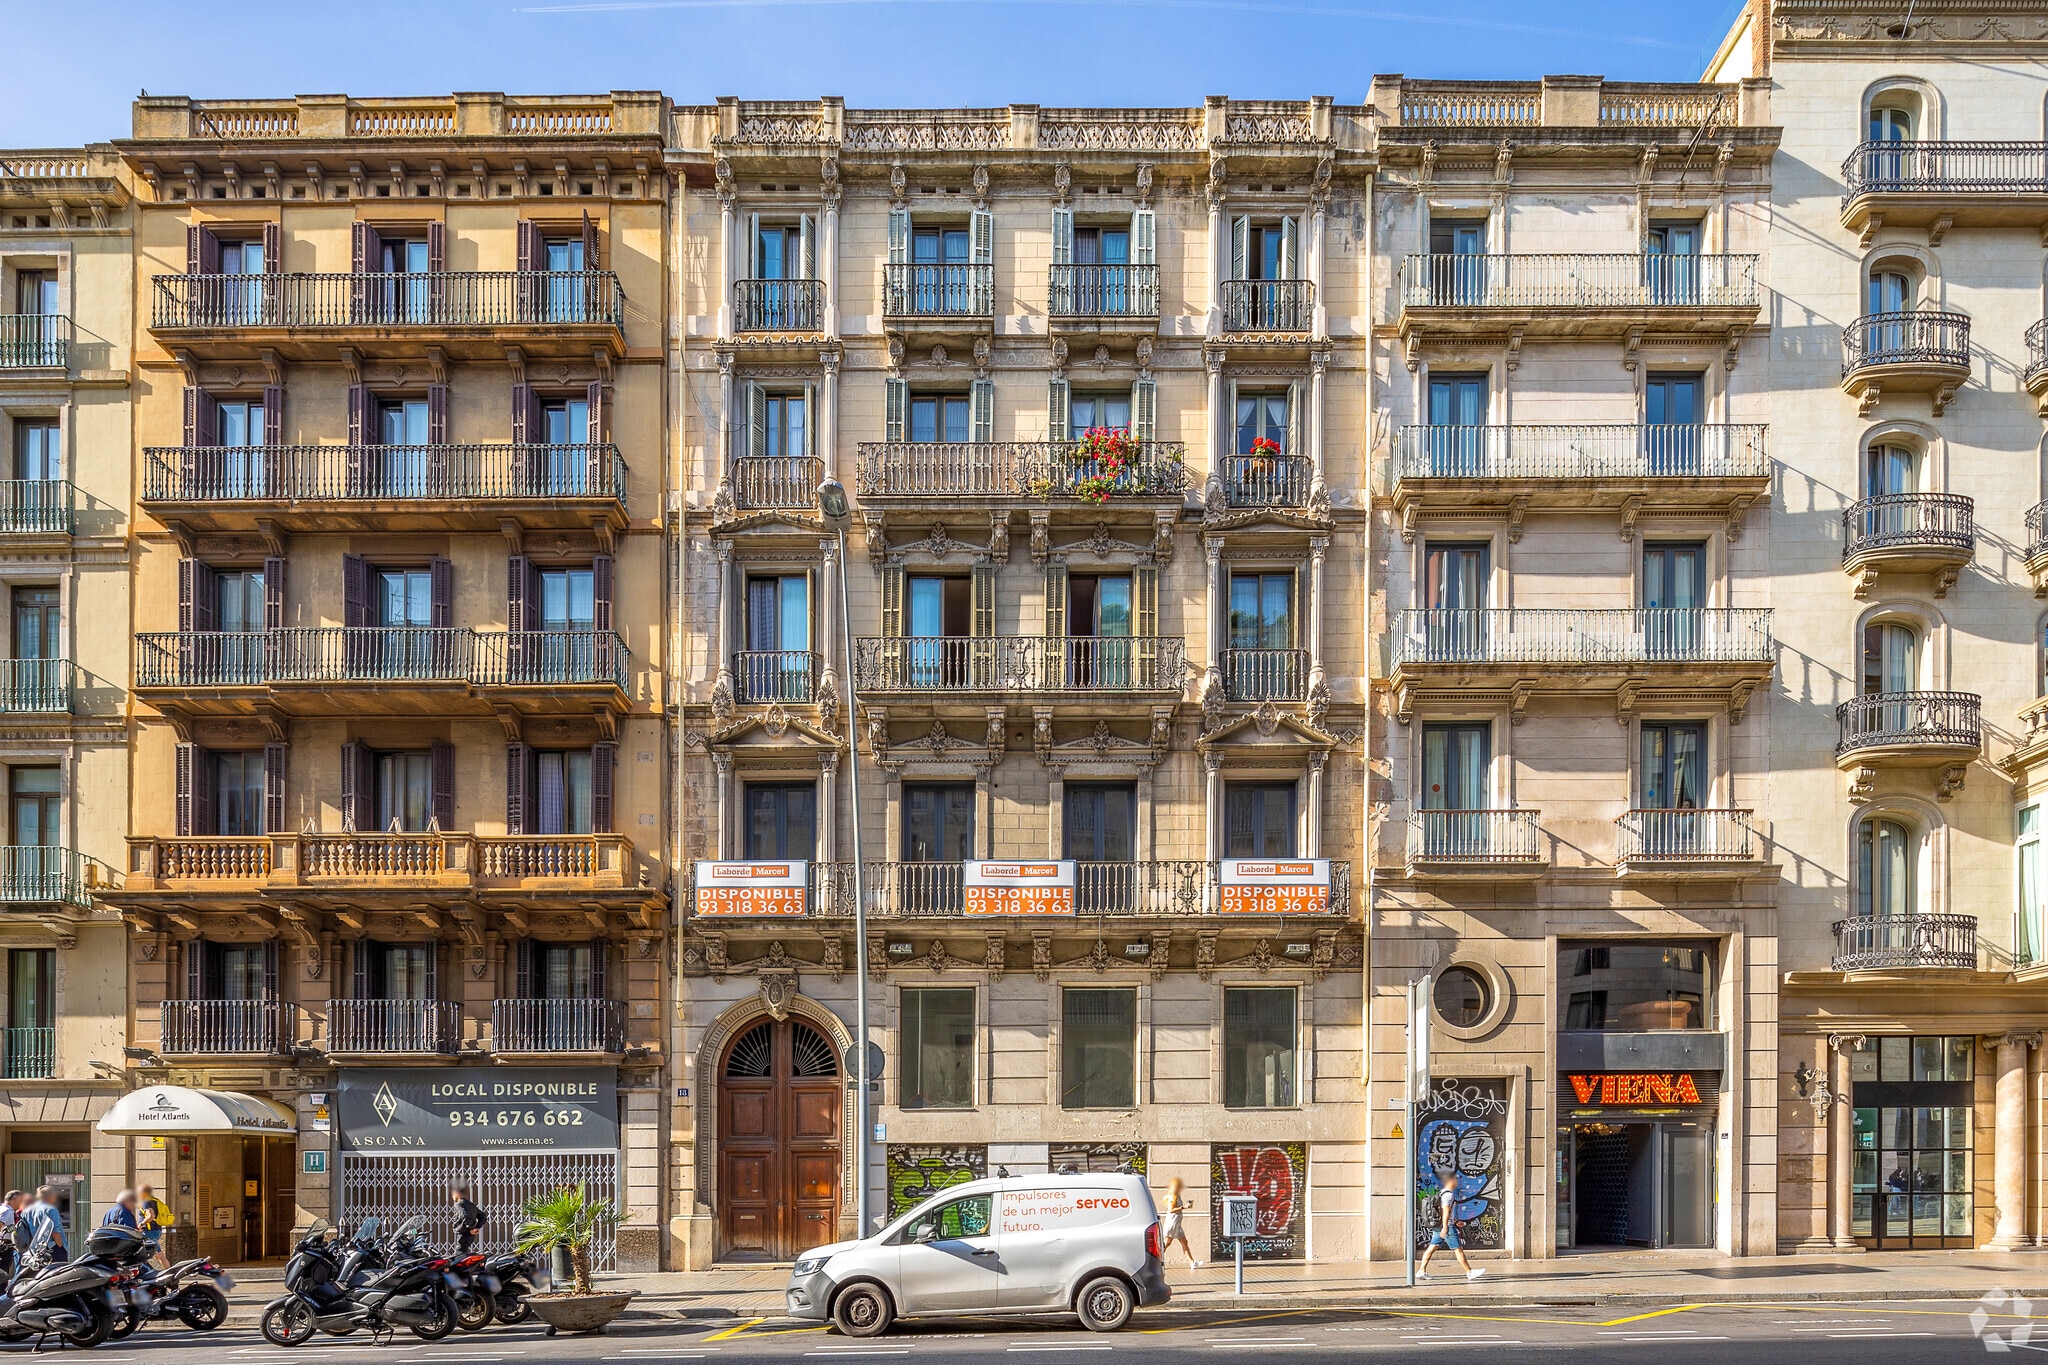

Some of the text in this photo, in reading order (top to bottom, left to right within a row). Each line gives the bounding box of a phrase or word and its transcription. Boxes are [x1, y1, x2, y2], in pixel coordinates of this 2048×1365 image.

[717, 867, 784, 875] Laborde Marcet
[985, 867, 1053, 875] Laborde Marcet
[1241, 865, 1309, 873] Laborde Marcet
[700, 889, 803, 899] DISPONIBLE
[968, 888, 1071, 899] DISPONIBLE
[1224, 887, 1327, 897] DISPONIBLE
[700, 901, 803, 913] 93 318 36 63
[968, 900, 1071, 913] 93 318 36 63
[1223, 899, 1326, 911] 93 318 36 63
[432, 1082, 598, 1097] LOCAL DISPONIBLE
[1567, 1074, 1702, 1104] VIENA
[236, 1116, 289, 1129] Hotel Atlantis
[449, 1109, 583, 1127] 934 676 662
[352, 1136, 426, 1146] ASCANA
[481, 1137, 554, 1145] www.ascana.es
[310, 1154, 319, 1166] H
[1002, 1190, 1067, 1203] Impulsores
[1076, 1198, 1130, 1209] serveo
[1003, 1204, 1074, 1217] de un mejor
[1003, 1221, 1044, 1232] futuro.
